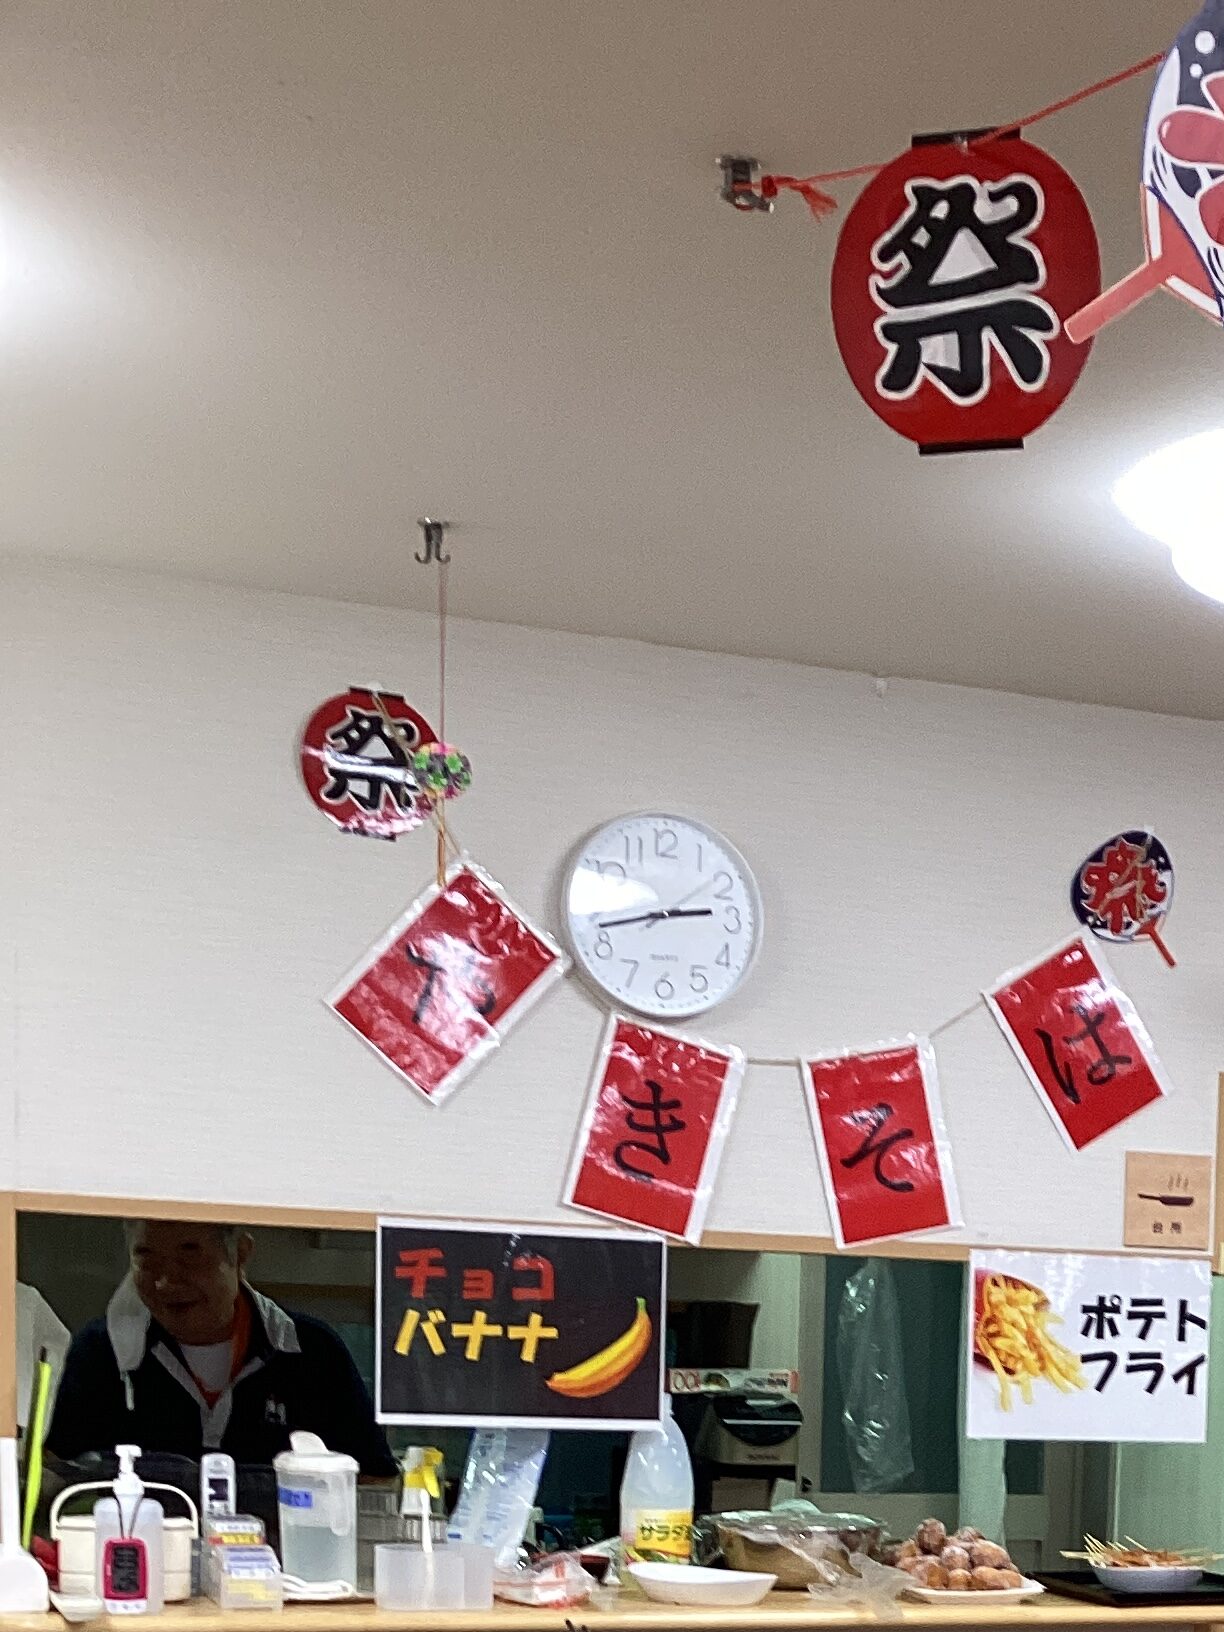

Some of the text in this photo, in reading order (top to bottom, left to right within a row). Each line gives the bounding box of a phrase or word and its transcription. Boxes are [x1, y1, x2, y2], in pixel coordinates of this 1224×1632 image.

[868, 173, 1060, 408] 祭
[322, 705, 422, 817] 祭
[624, 834, 644, 866] 11
[653, 828, 679, 860] 12
[713, 870, 734, 901] 2
[723, 905, 742, 935] 3
[593, 930, 613, 960] 8
[714, 942, 730, 969] 4
[619, 958, 640, 988] 7
[654, 972, 675, 1000] 6
[689, 964, 709, 994] 5
[612, 1079, 686, 1183] き
[840, 1102, 917, 1193] そ
[394, 1247, 556, 1301] チョコ
[1080, 1294, 1207, 1342] ポテト
[393, 1308, 560, 1364] バナナ
[1080, 1351, 1206, 1396] フライ
